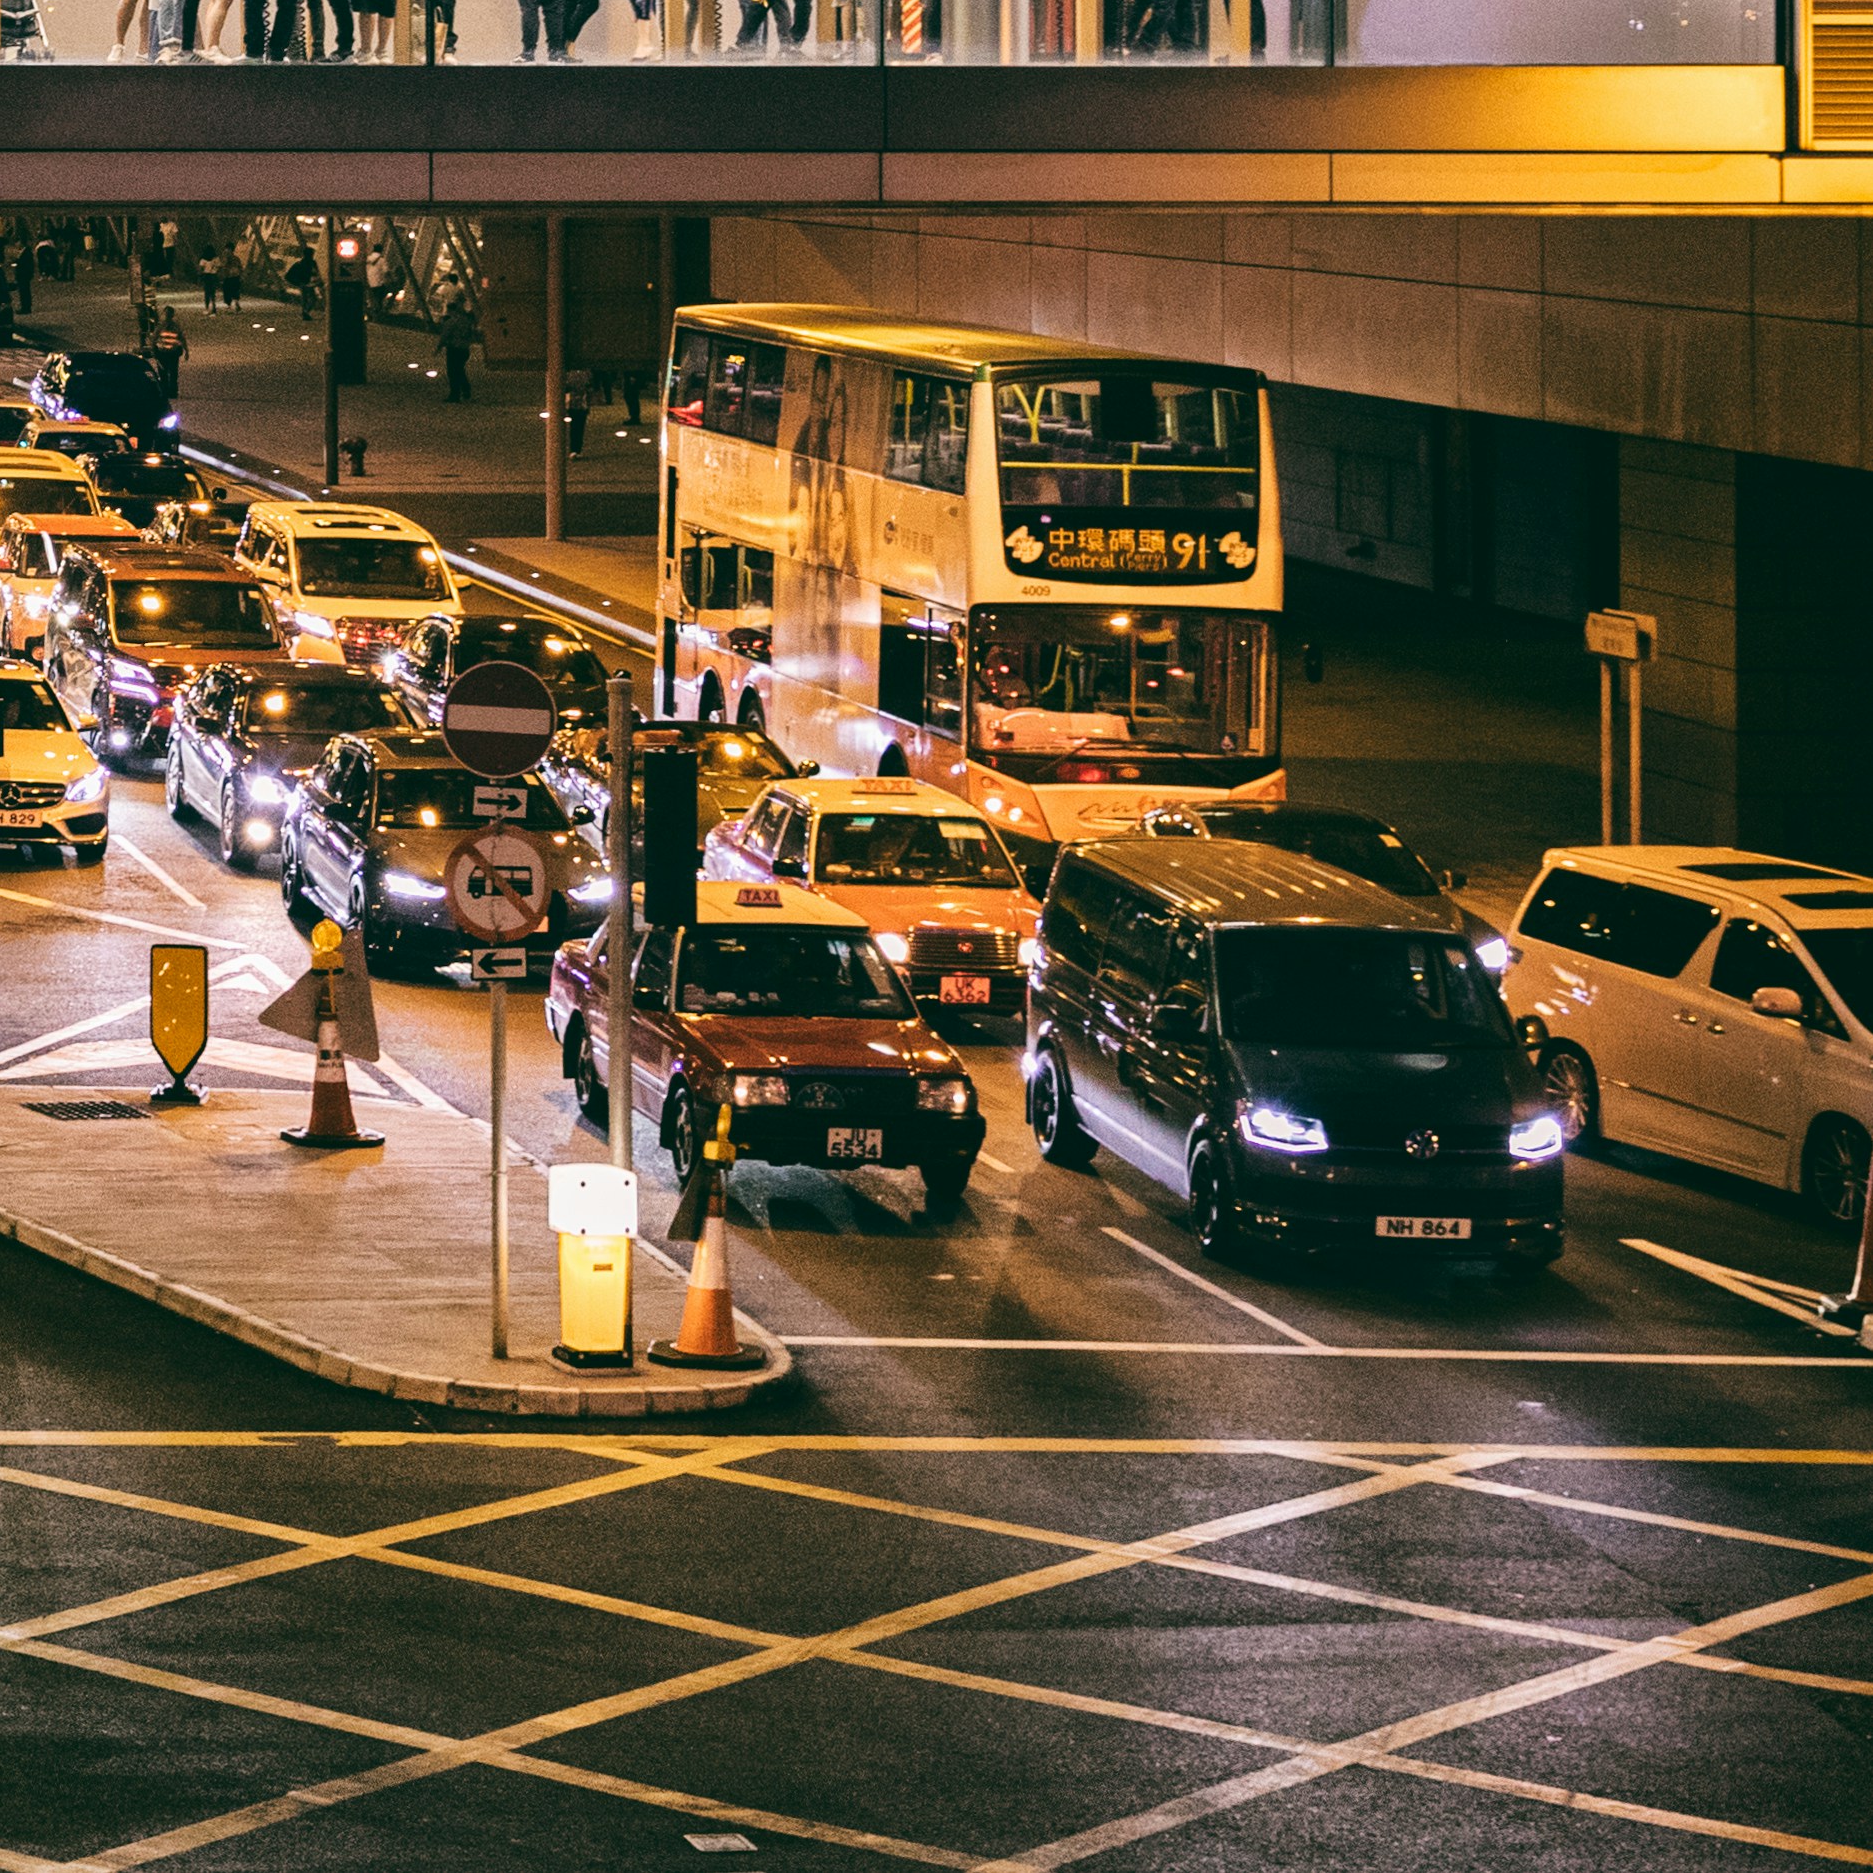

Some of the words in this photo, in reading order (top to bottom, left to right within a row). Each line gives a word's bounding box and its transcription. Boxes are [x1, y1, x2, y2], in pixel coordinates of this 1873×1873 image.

[1048, 527, 1166, 553] 中環碼頭
[1171, 532, 1207, 570] 91
[1047, 552, 1116, 570] Central
[1021, 585, 1051, 597] 4009
[861, 779, 913, 792] TAXI
[9, 814, 36, 825] 829
[742, 889, 779, 903] TAXI
[831, 1139, 879, 1157] 5534
[1386, 1219, 1413, 1235] NH
[1421, 1220, 1460, 1236] 864
